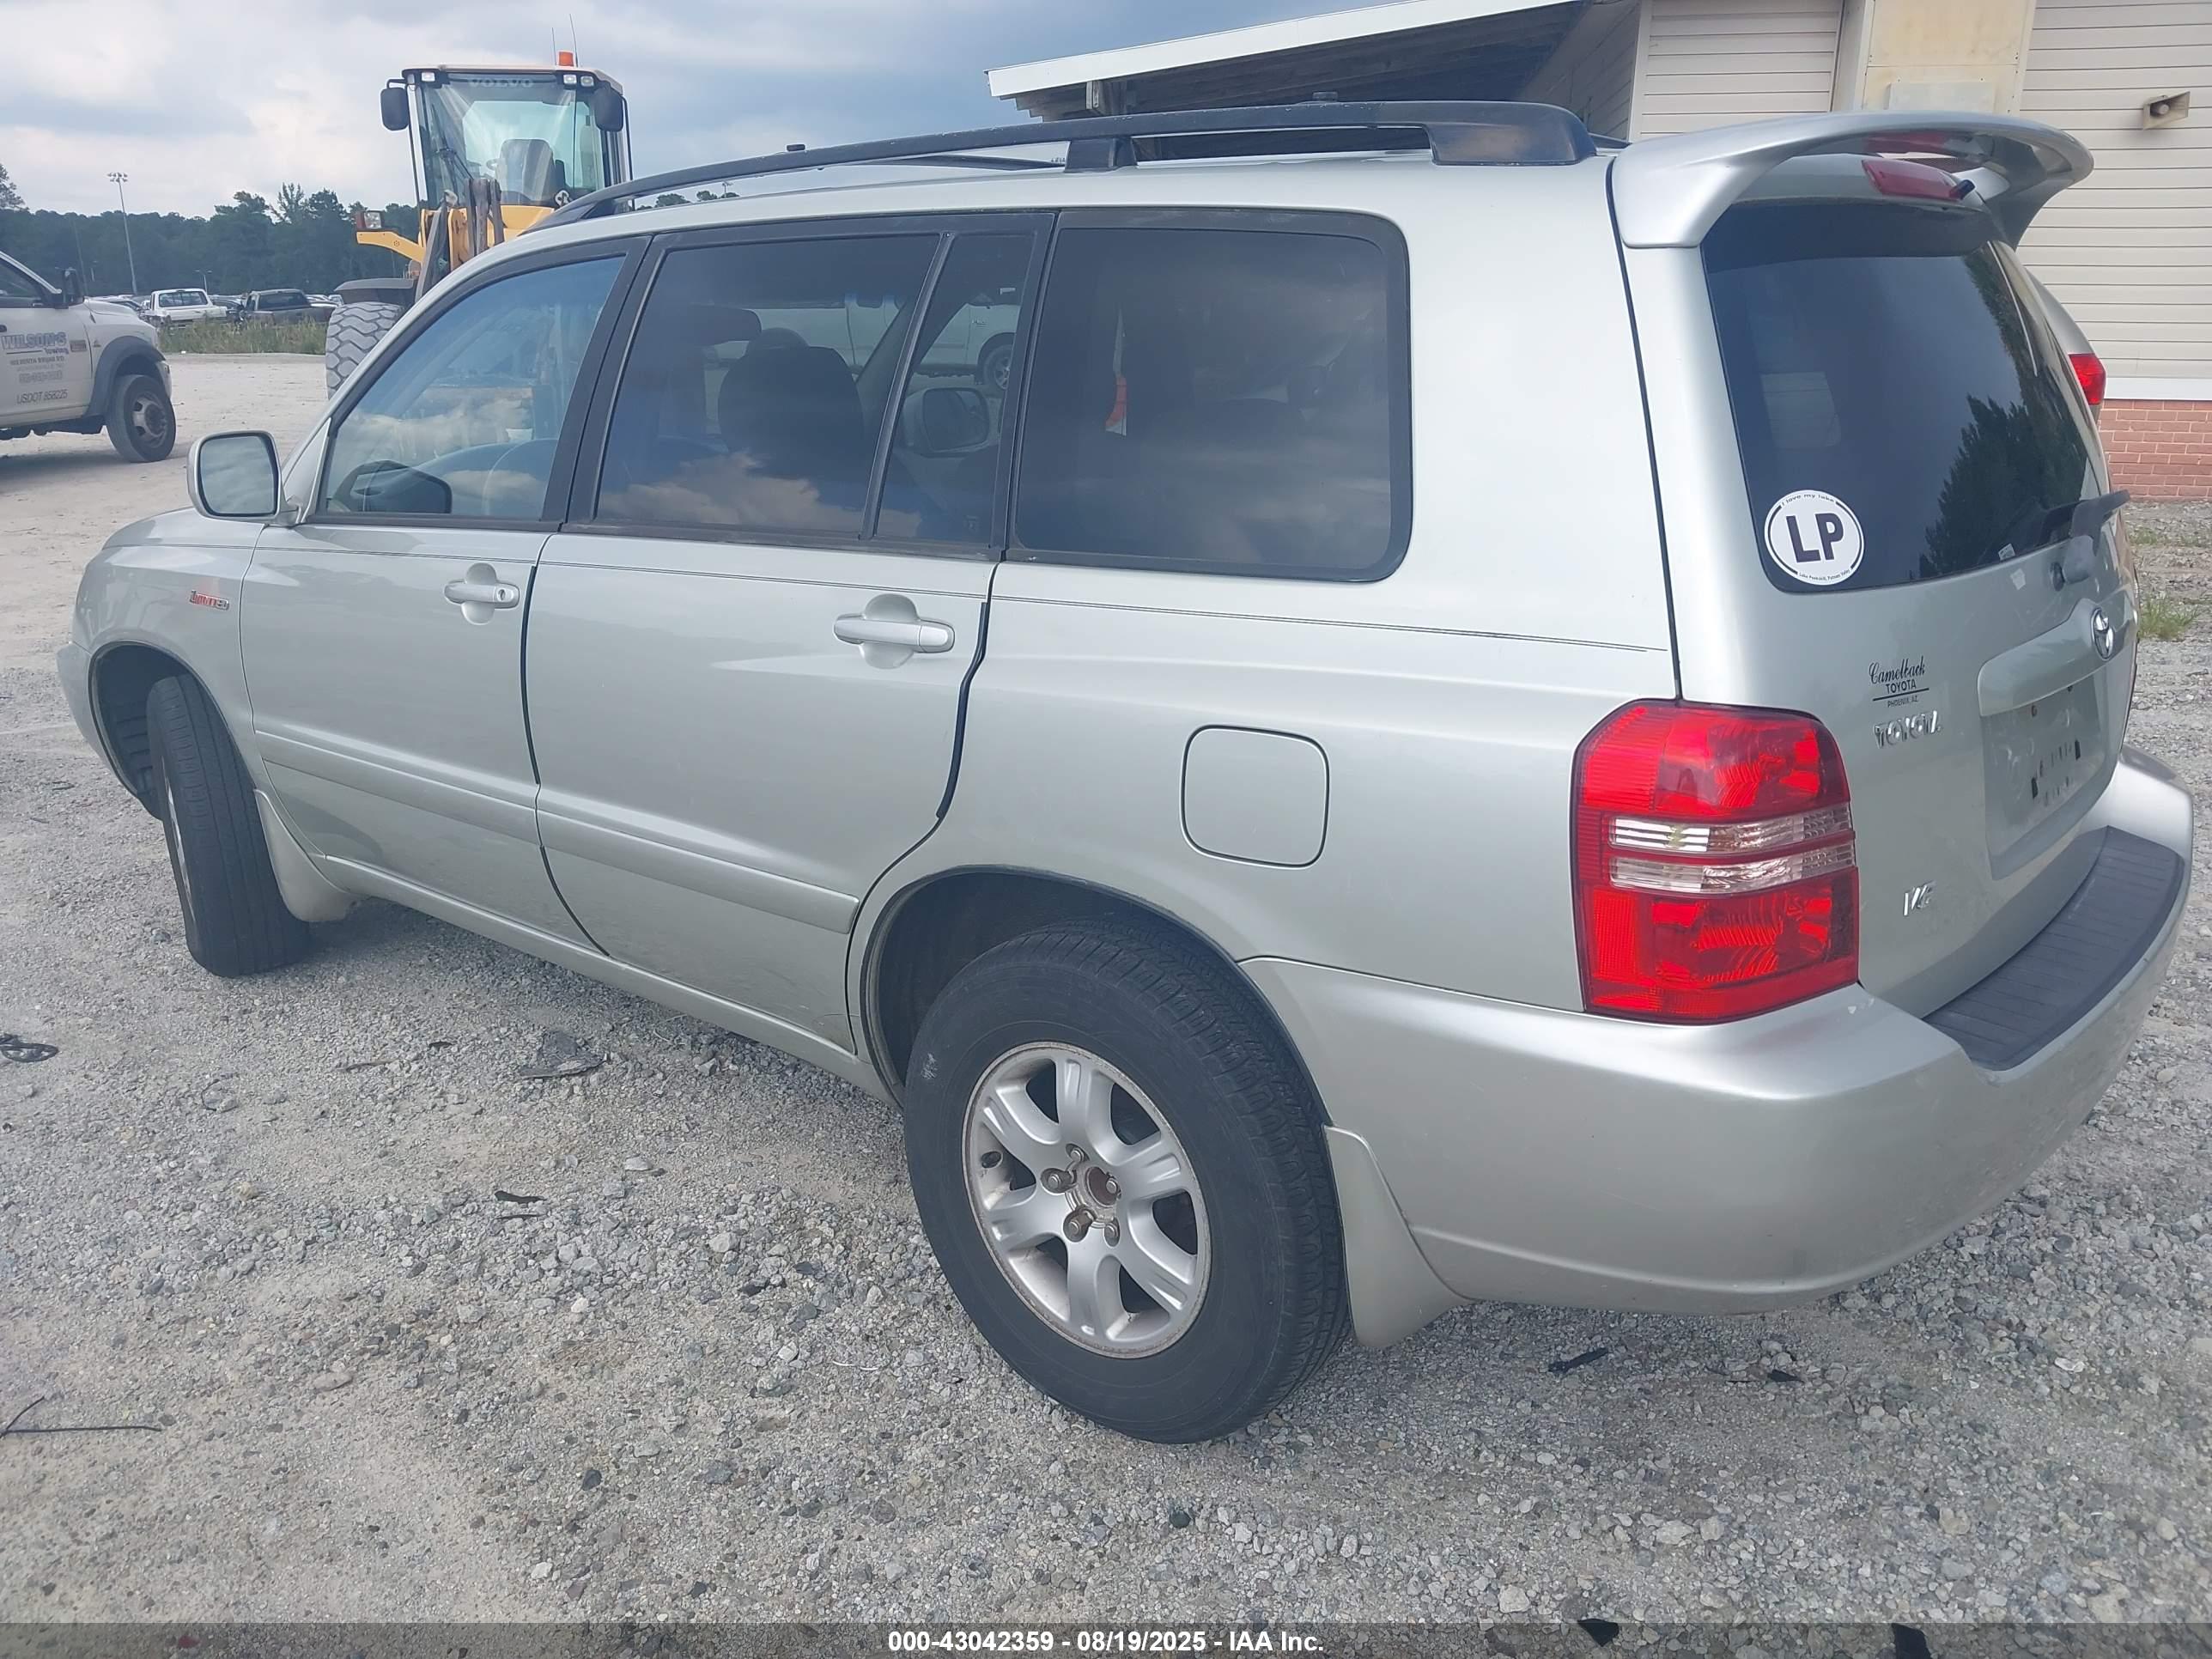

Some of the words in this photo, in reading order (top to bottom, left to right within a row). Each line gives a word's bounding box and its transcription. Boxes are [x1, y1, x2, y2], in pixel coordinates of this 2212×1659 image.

[1786, 513, 1844, 562] LP
[1886, 678, 1917, 694] TOYOTA
[1875, 709, 1942, 749] TOYOTA
